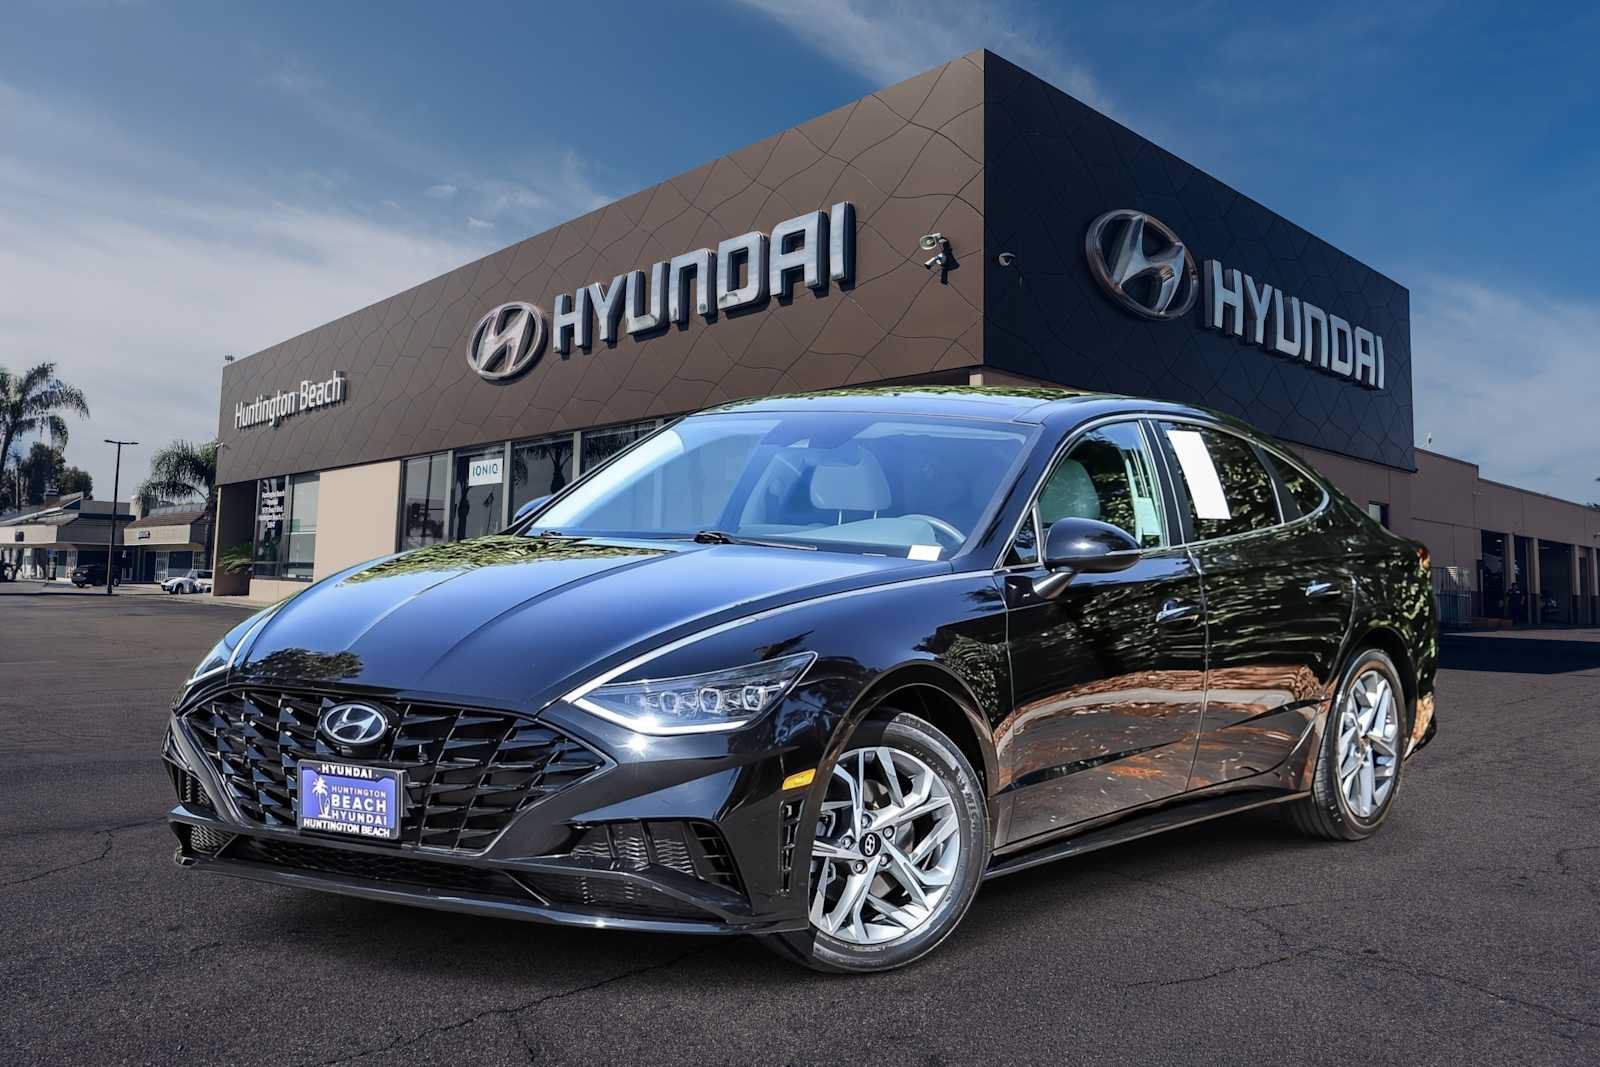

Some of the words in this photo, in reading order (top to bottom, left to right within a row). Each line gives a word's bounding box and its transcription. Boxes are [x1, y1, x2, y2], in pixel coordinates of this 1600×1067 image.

[553, 201, 856, 359] HYUNDAI
[1204, 258, 1385, 390] HYUNDAI
[234, 390, 299, 429] Huntington
[299, 369, 345, 411] Beach
[472, 463, 498, 477] IONIQ
[321, 763, 373, 779] HYUNDAI
[331, 785, 386, 798] HUNTINGTON
[331, 794, 387, 813] BEACH
[331, 810, 387, 826] HYUNDAI
[303, 818, 359, 833] HUNTINGTON
[360, 825, 390, 838] BEACH
